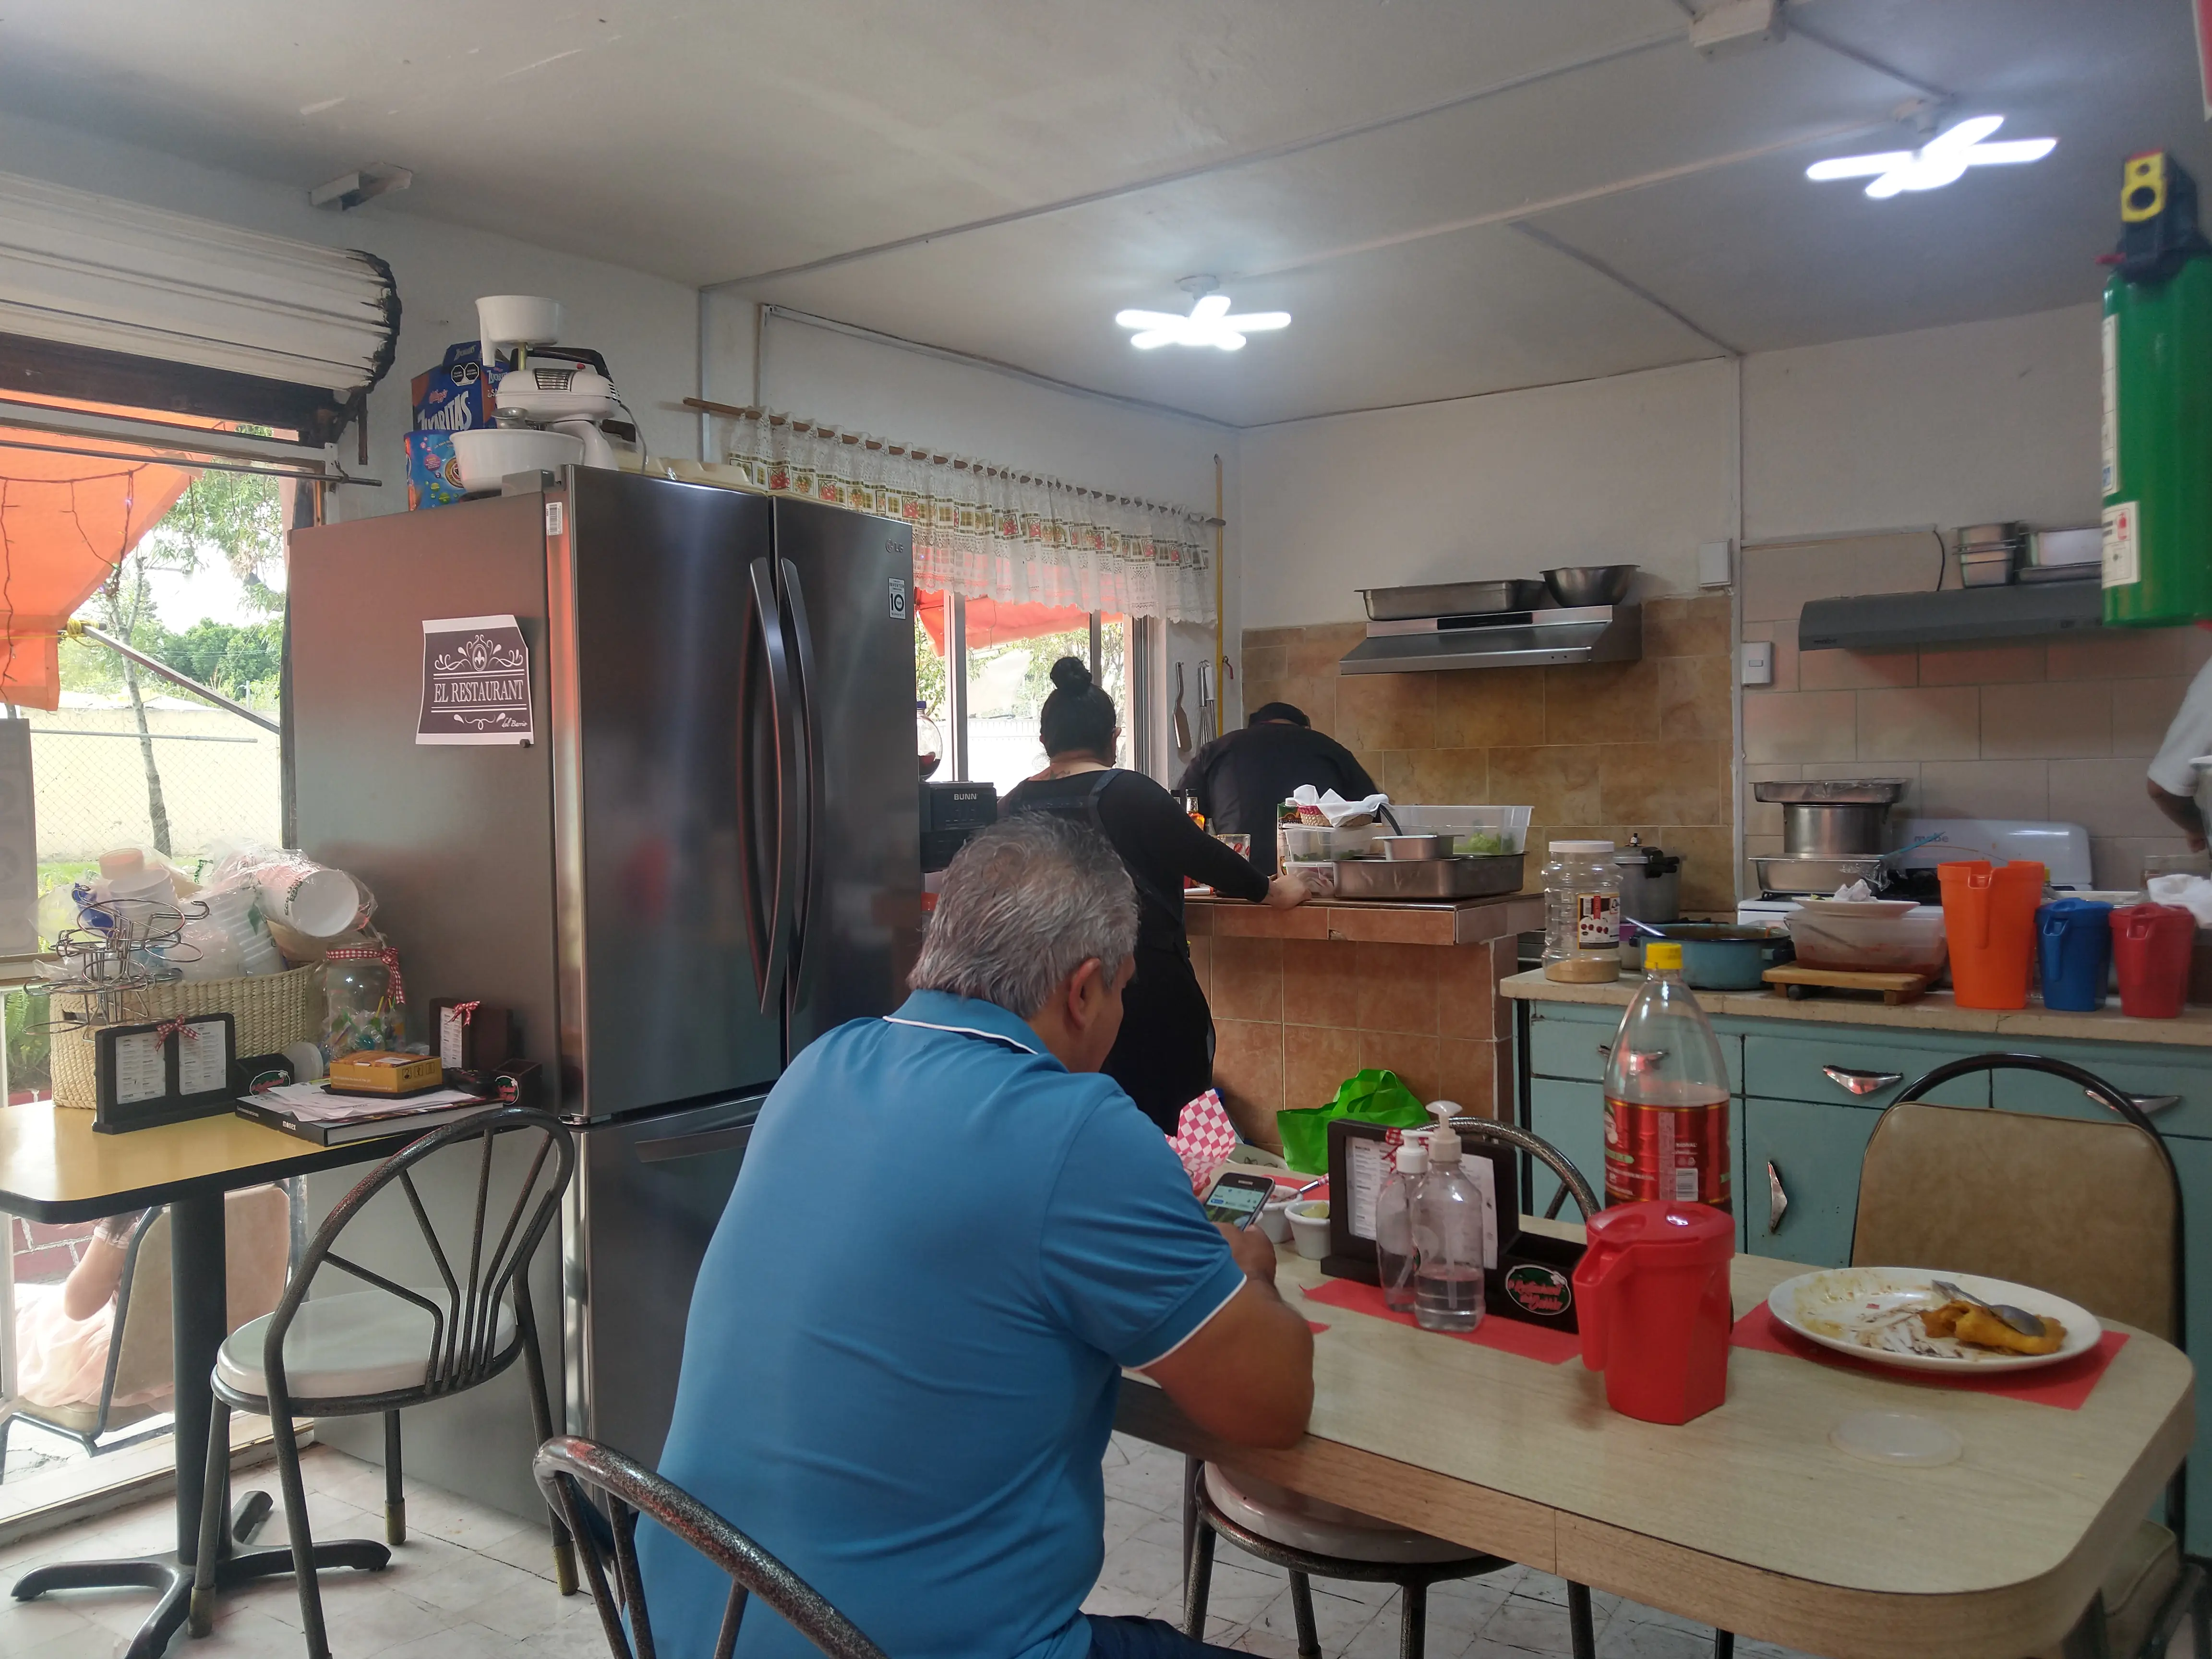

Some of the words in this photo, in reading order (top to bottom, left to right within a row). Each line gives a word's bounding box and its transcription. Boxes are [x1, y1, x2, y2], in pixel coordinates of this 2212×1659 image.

[890, 593, 904, 612] 10
[433, 683, 448, 702] EL
[451, 679, 524, 702] RESTAURANT
